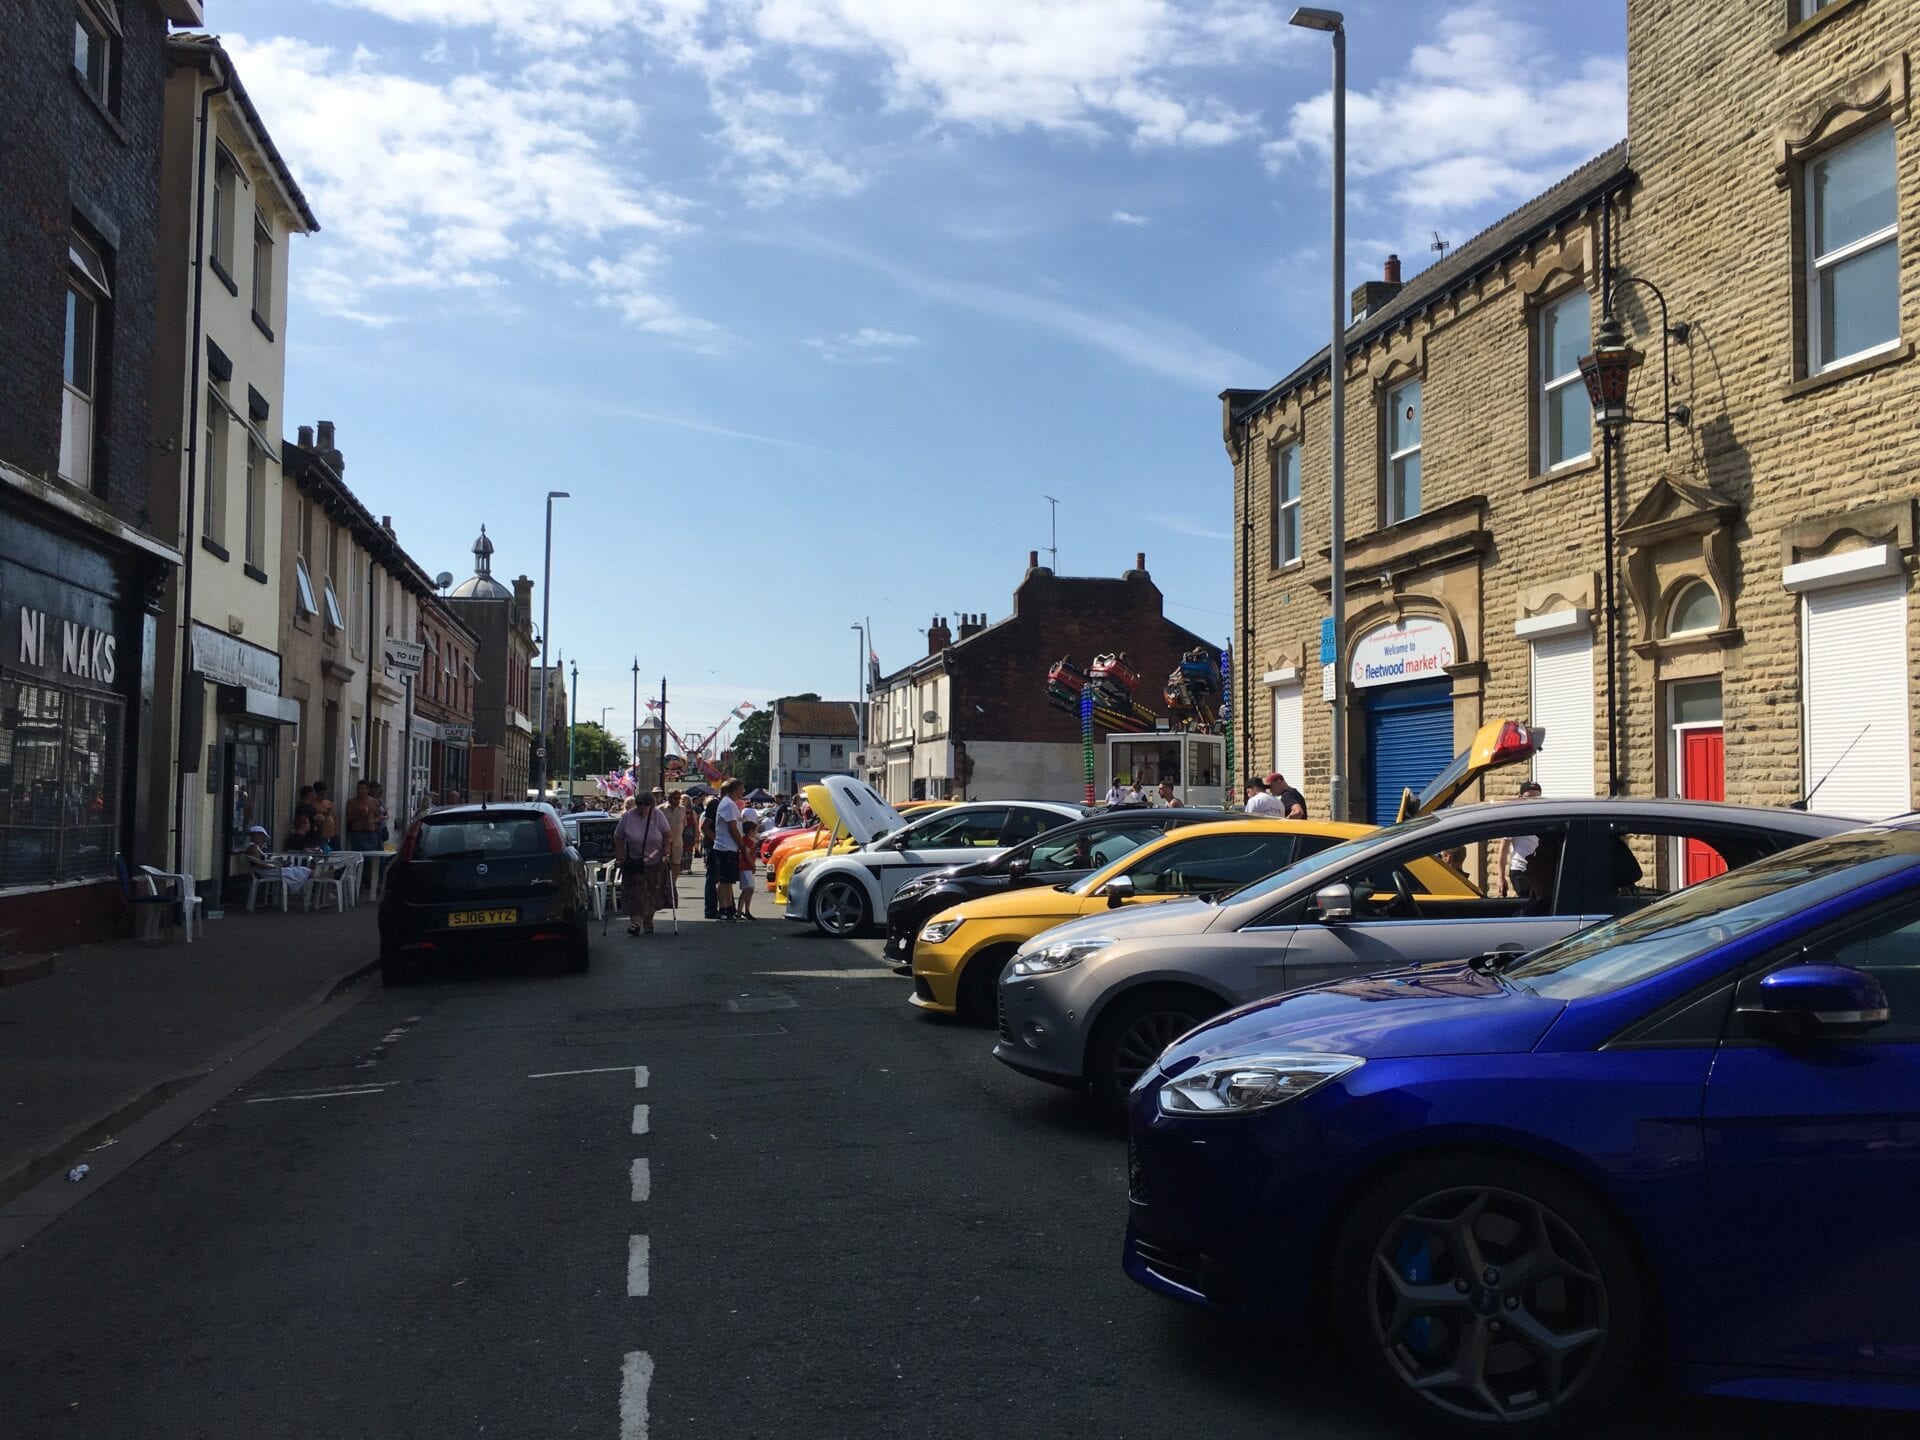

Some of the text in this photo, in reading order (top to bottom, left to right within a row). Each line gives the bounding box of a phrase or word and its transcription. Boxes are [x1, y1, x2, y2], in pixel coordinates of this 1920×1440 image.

[20, 606, 116, 684] NI NAKS
[1384, 642, 1416, 656] Welcome to
[396, 651, 421, 662] TO LET
[1365, 655, 1438, 680] fleetwood market
[444, 728, 464, 736] CAFE
[454, 910, 513, 924] SJ06 YTZ
